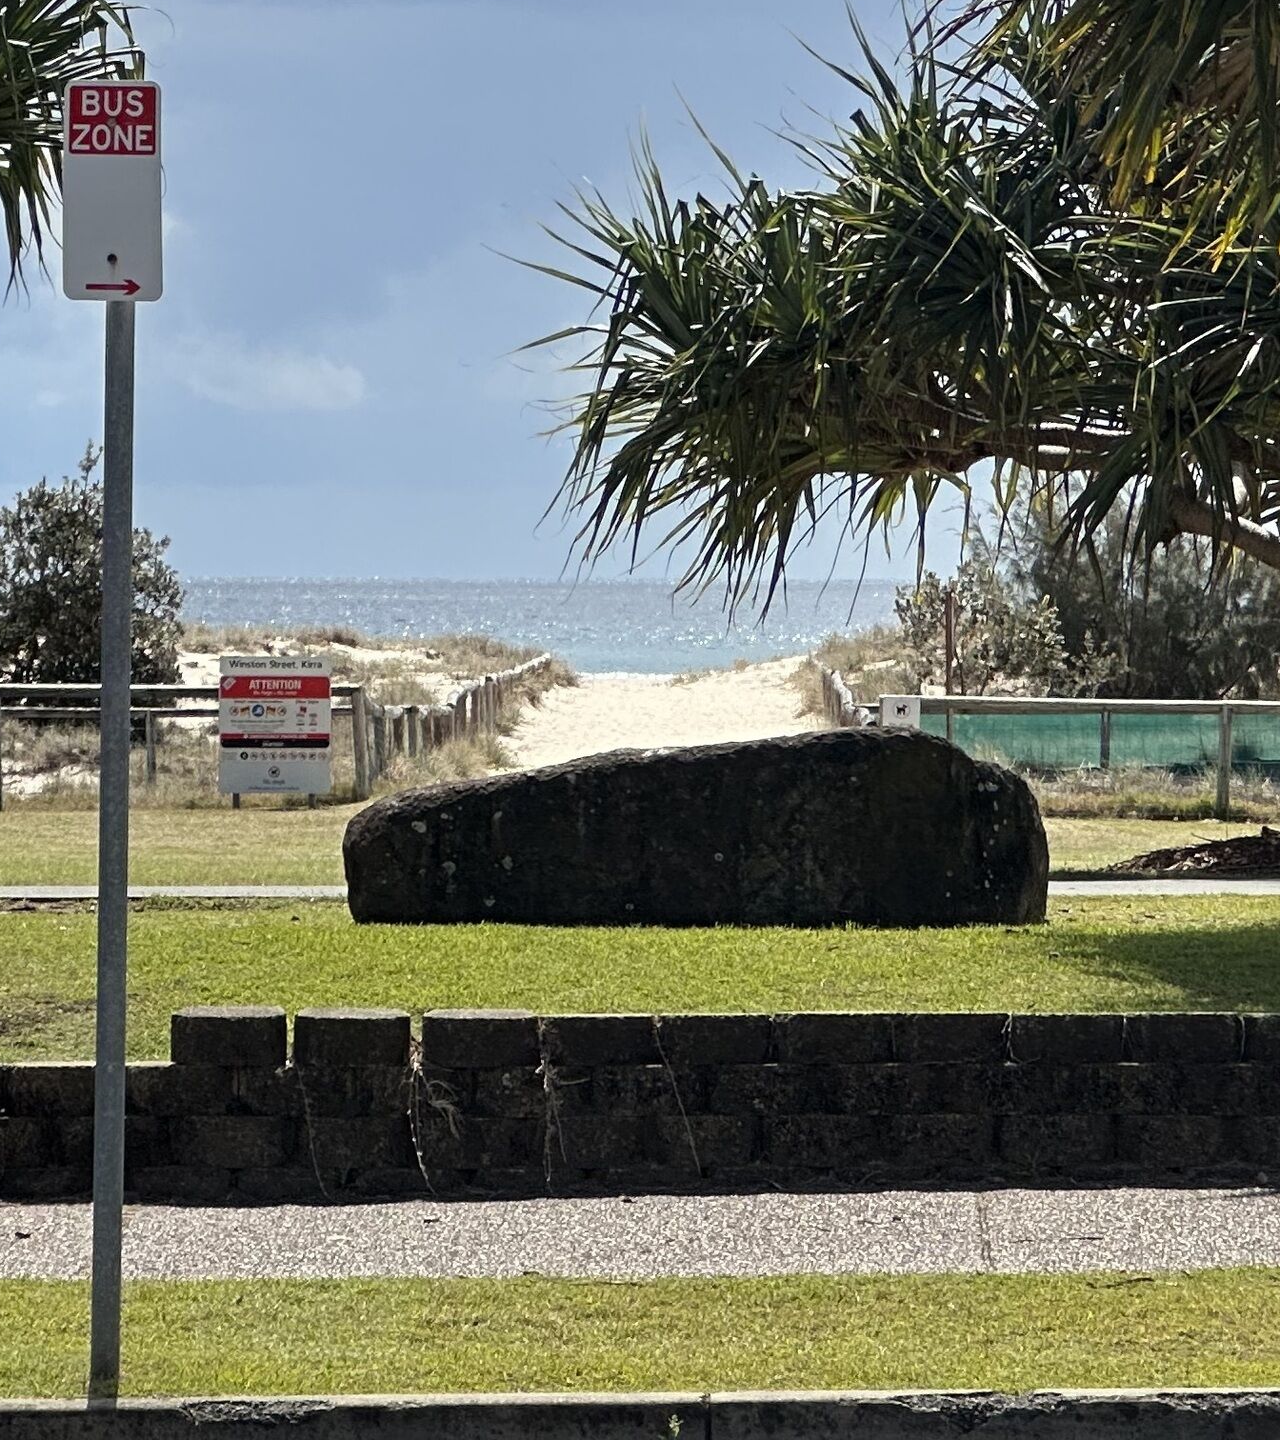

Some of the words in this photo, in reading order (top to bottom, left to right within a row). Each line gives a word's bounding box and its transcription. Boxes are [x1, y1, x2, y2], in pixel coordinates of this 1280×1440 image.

[81, 90, 144, 117] BUS
[71, 123, 153, 151] ZONE
[229, 659, 267, 669] Winston
[301, 659, 323, 669] Kirra
[249, 679, 302, 690] ATTENTION
